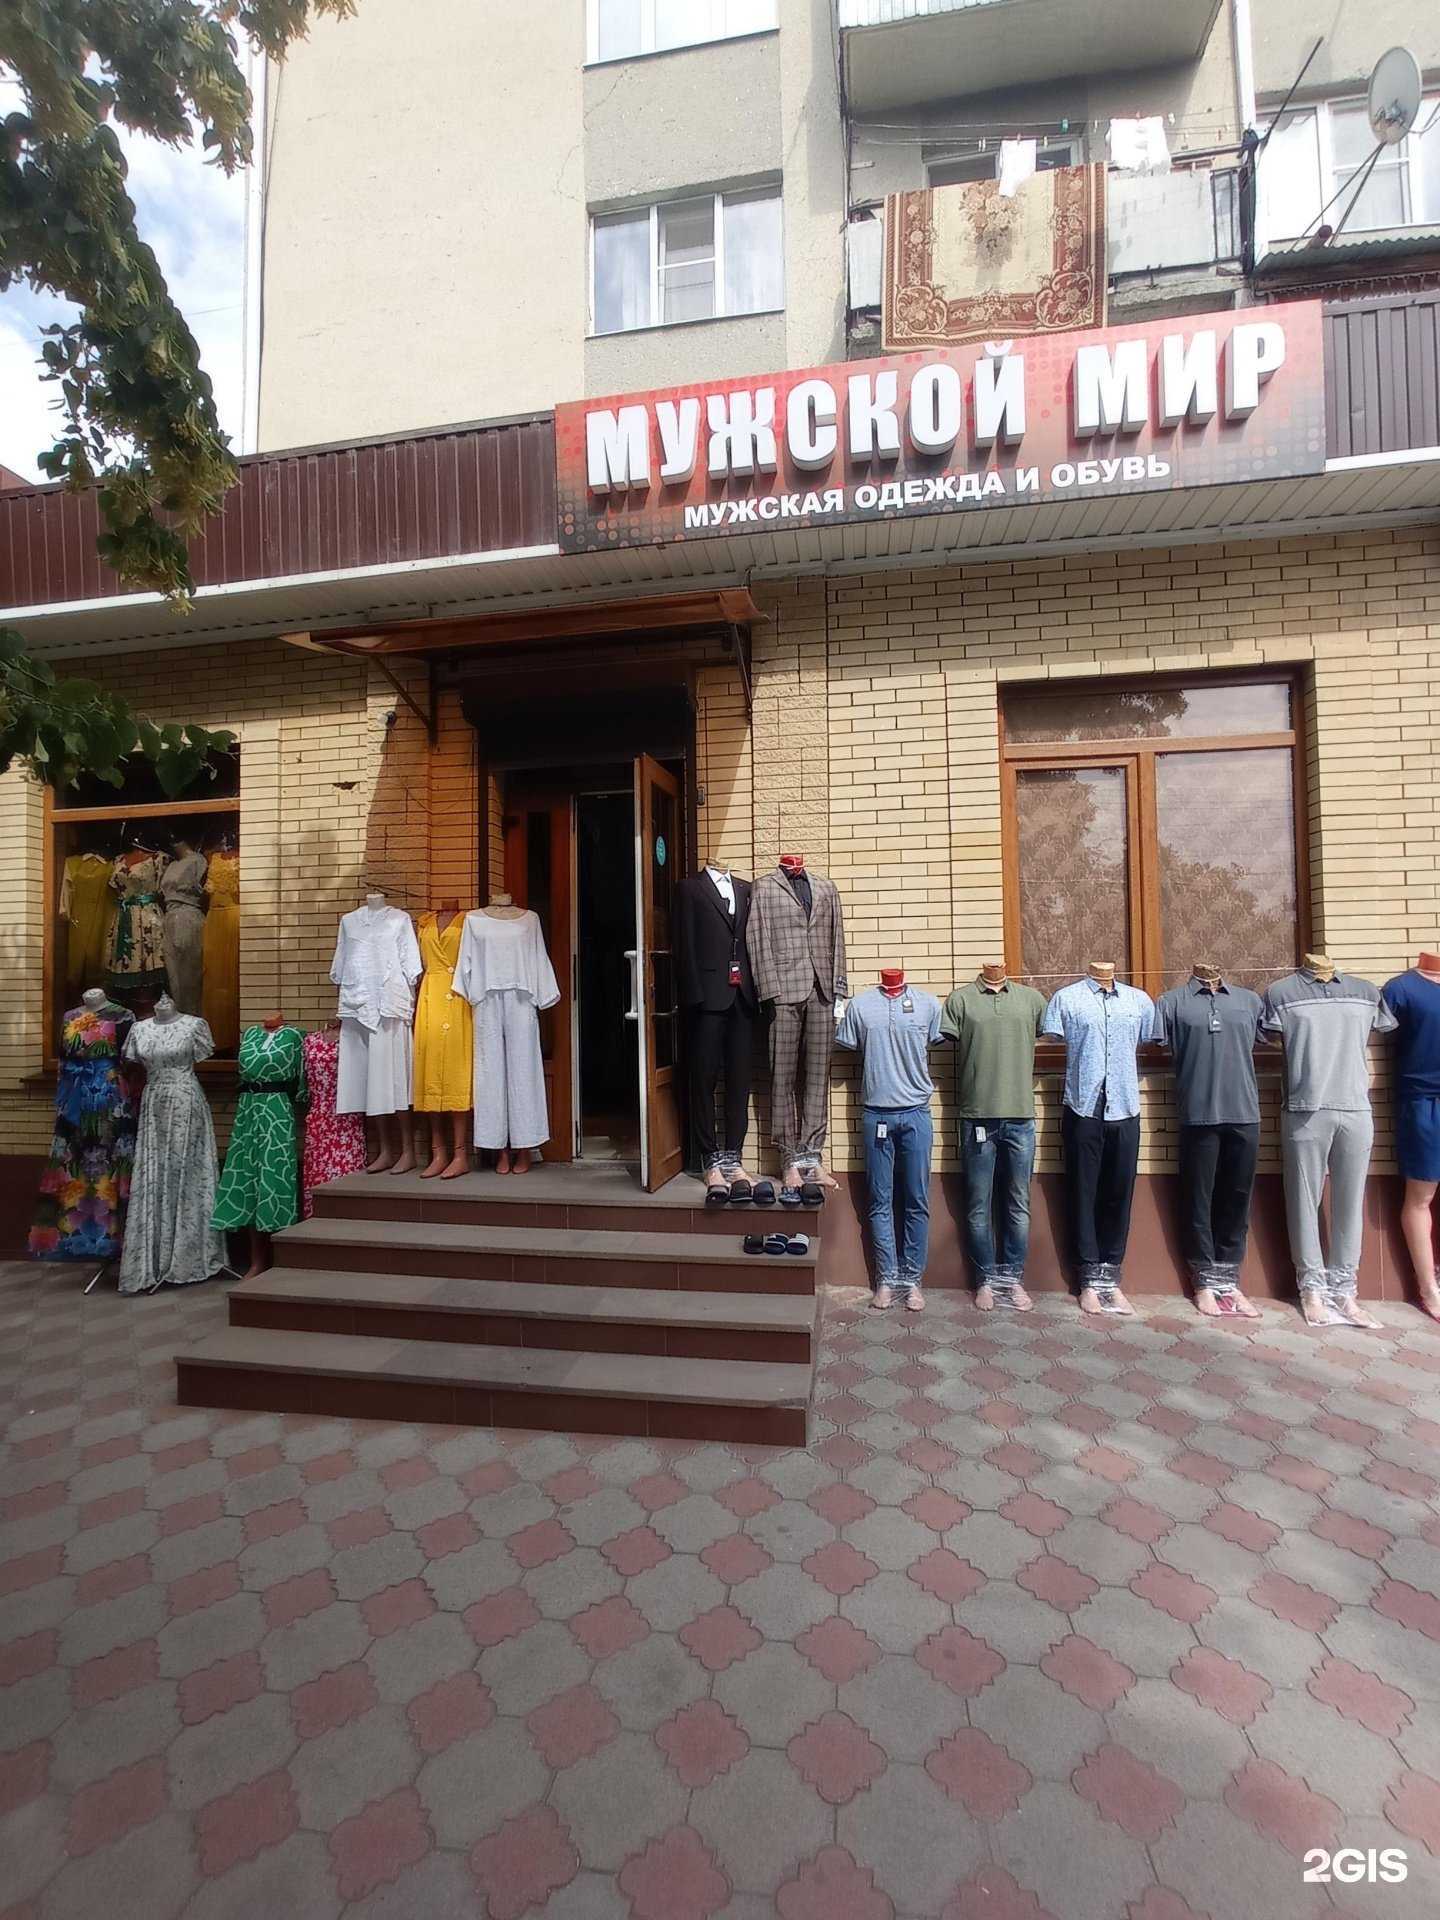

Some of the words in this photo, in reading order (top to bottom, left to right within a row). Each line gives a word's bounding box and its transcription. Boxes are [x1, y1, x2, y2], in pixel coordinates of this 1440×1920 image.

[586, 338, 1027, 490] МУЖСКОЙ
[1075, 321, 1286, 434] МИР
[683, 487, 845, 529] МУЖСКАЯ
[854, 471, 1006, 511] ОДЕЖДА
[1015, 466, 1041, 493] И
[1050, 454, 1171, 488] ОБУВЬ
